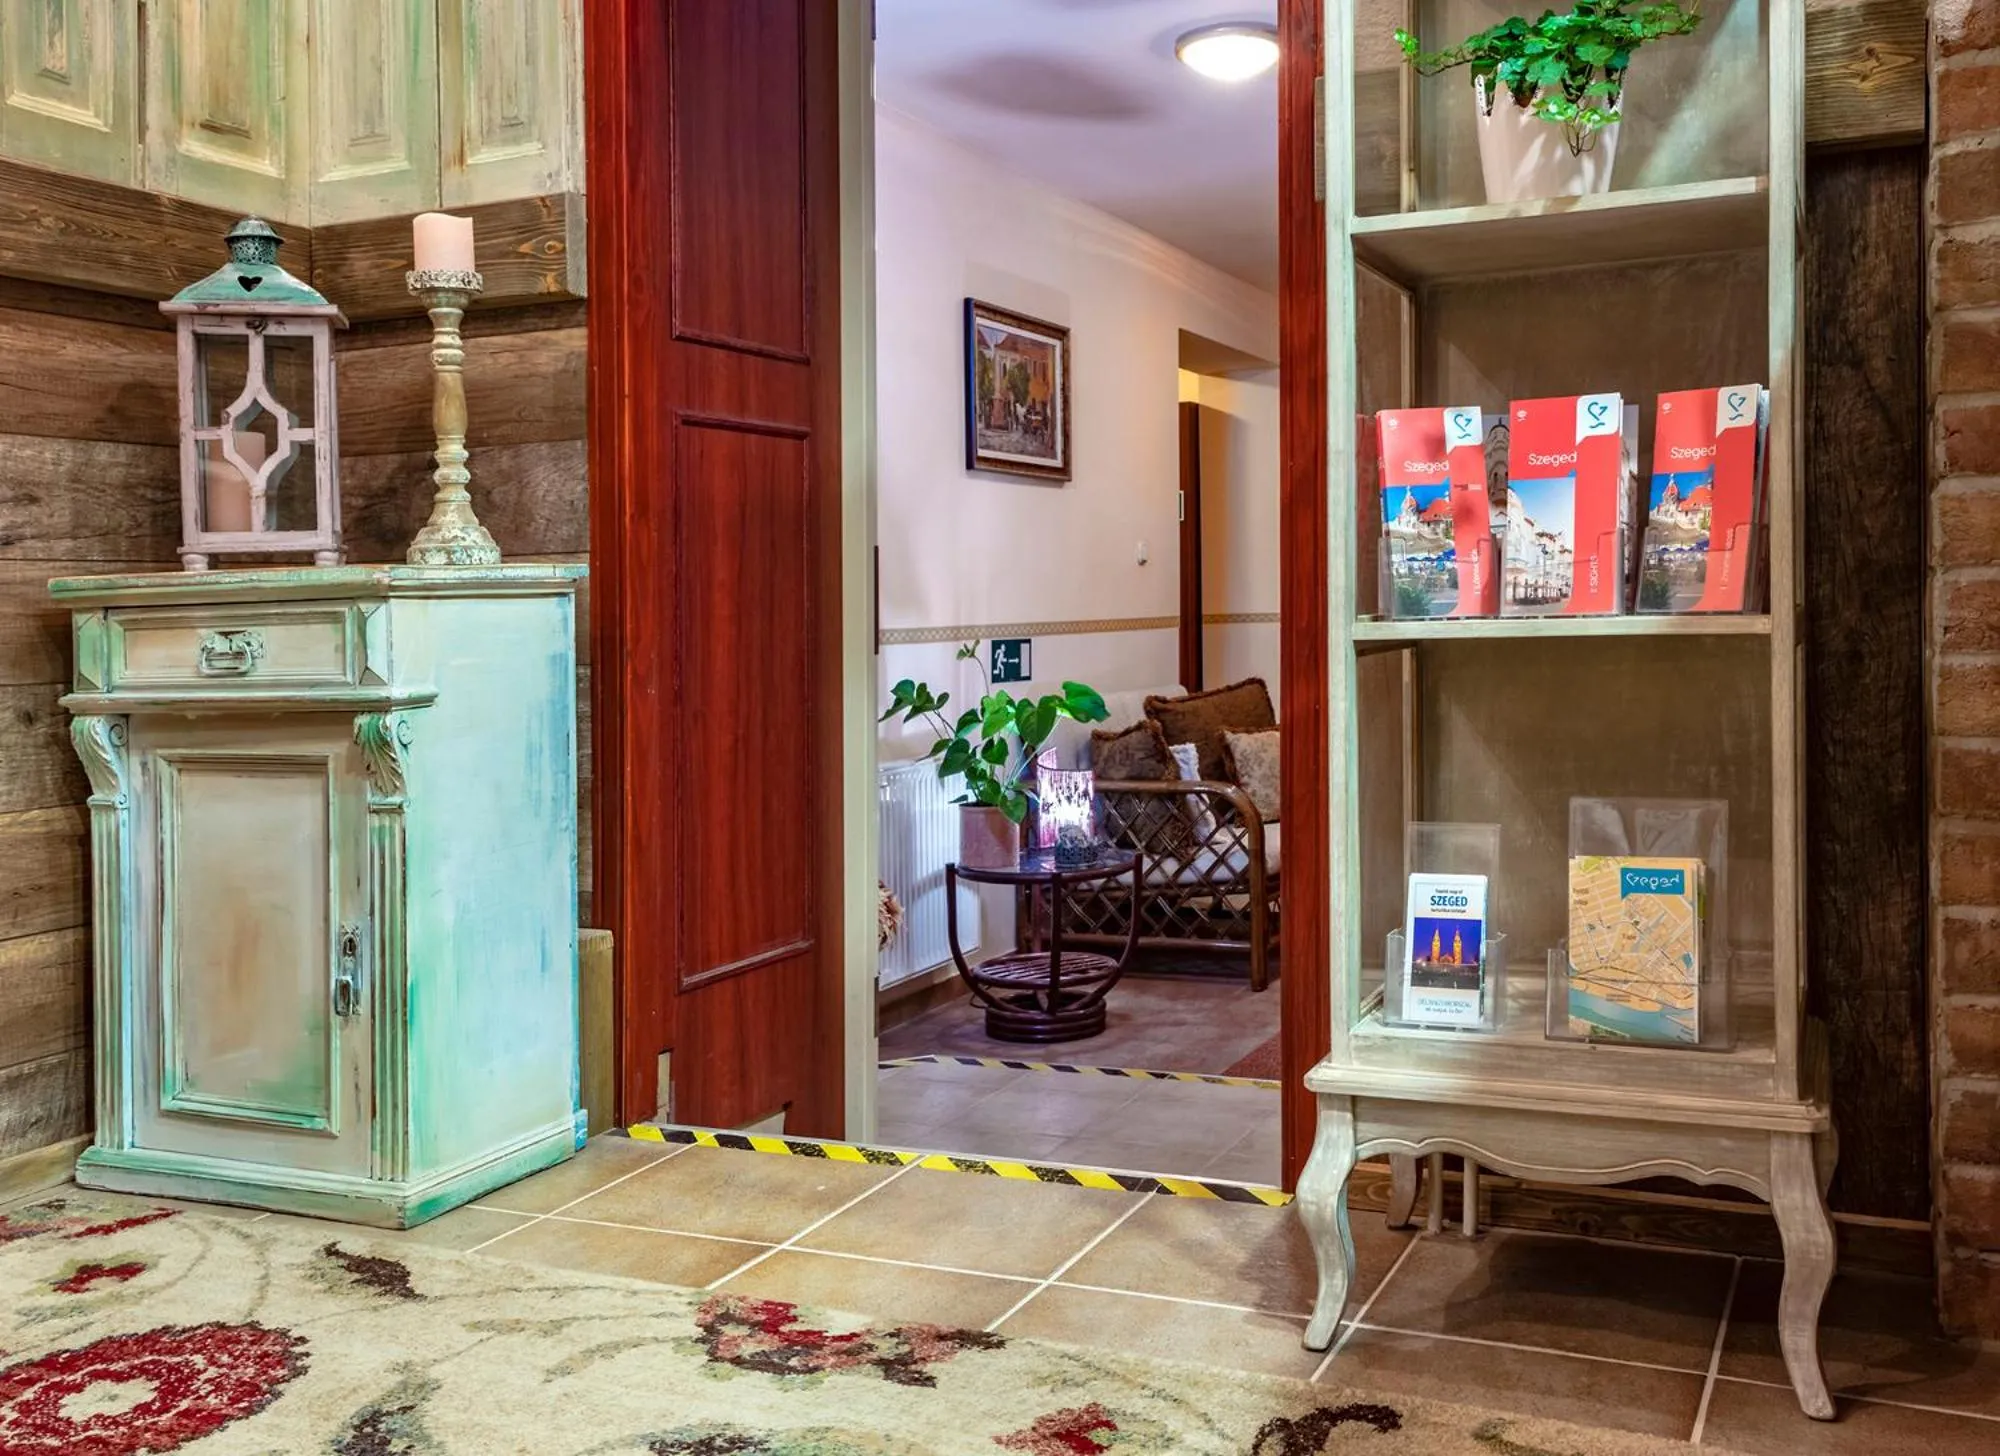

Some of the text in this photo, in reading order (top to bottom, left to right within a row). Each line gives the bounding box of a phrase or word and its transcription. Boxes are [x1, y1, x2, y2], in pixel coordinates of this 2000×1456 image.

[1528, 451, 1577, 467] Szeged
[1670, 444, 1717, 460] Szeged
[1403, 460, 1449, 474] Szeged
[1430, 895, 1468, 906] SZEGED
